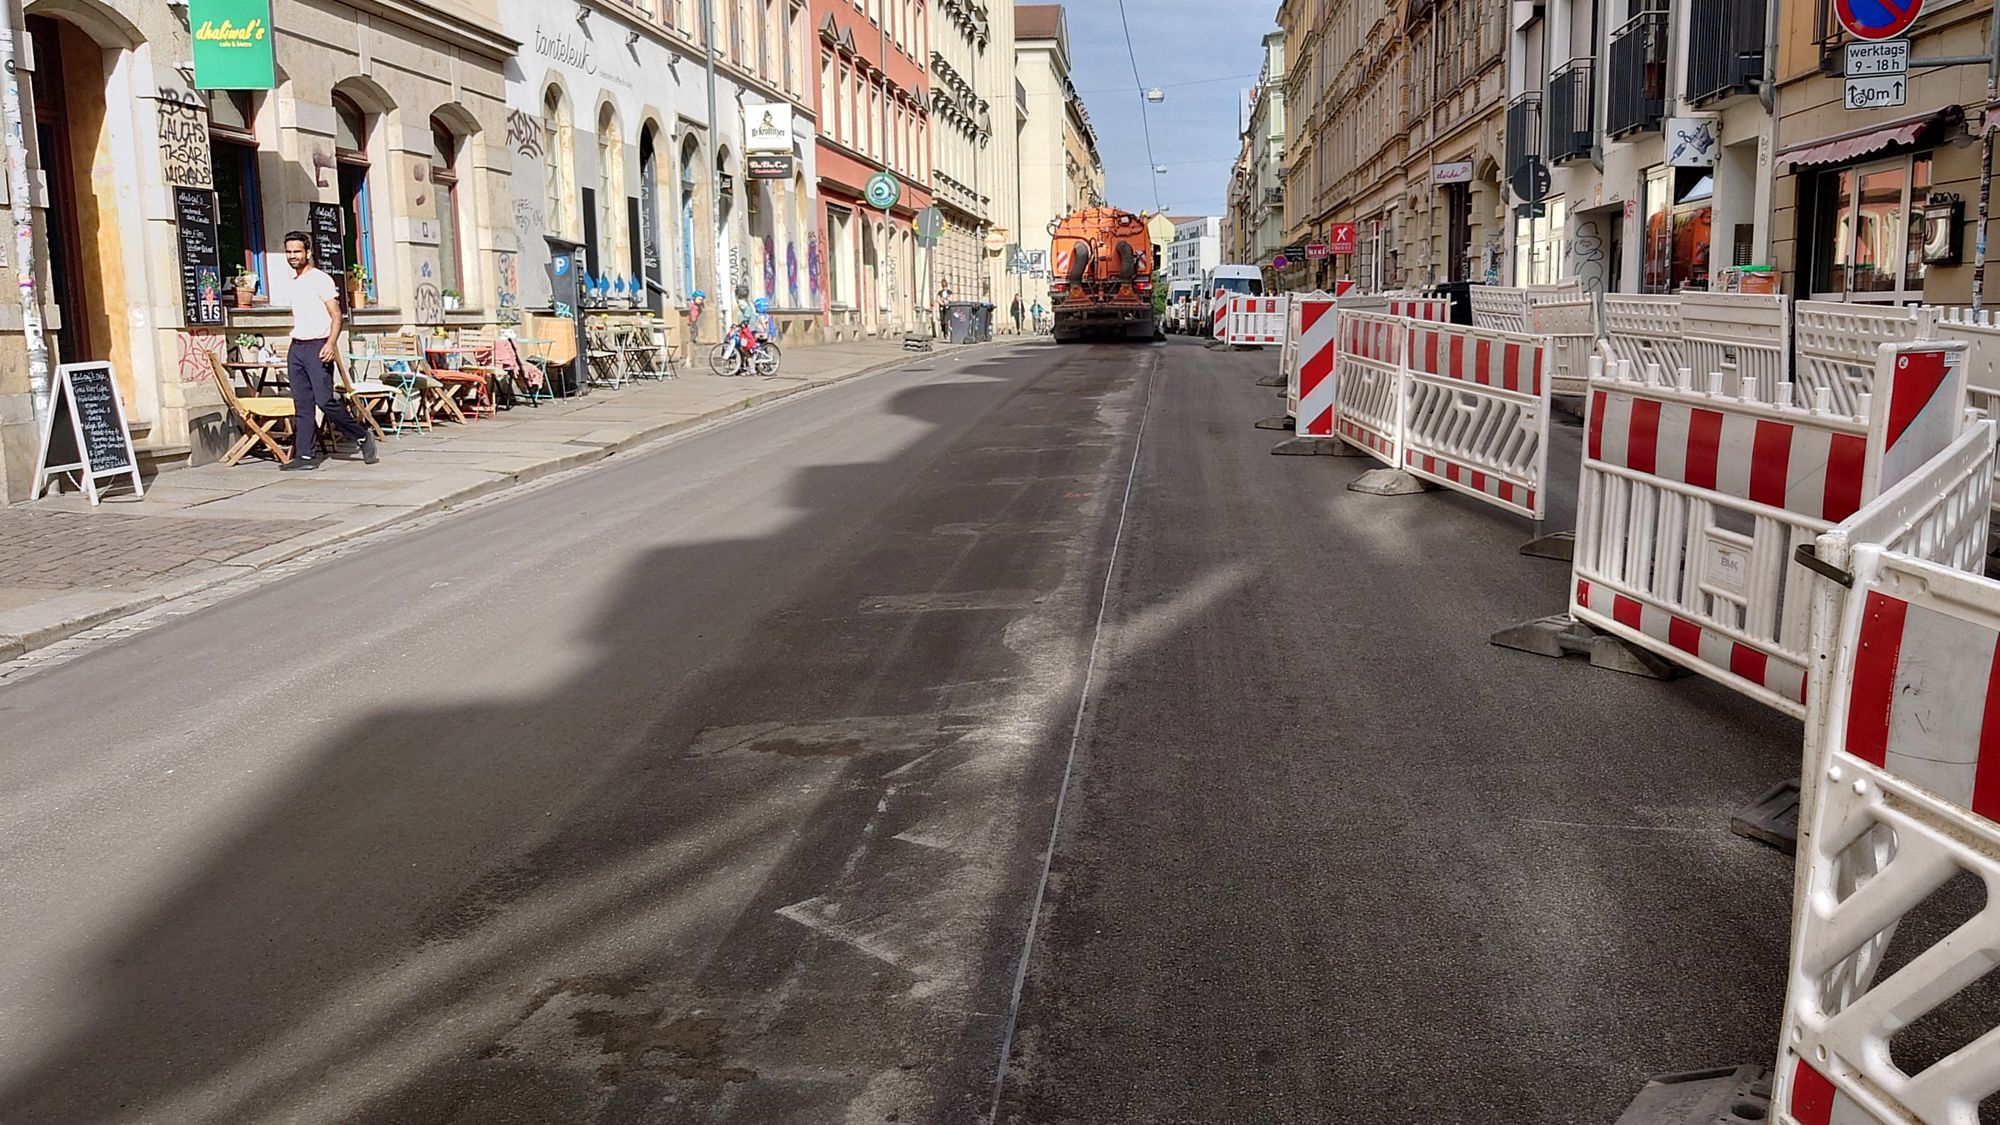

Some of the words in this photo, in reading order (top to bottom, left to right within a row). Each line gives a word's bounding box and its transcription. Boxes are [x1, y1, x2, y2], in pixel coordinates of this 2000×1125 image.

[195, 18, 265, 40] dhaliwal's
[1850, 45, 1905, 57] werktags
[1855, 61, 1862, 72] 9
[1876, 60, 1889, 71] 18
[556, 257, 565, 272] P
[201, 305, 221, 320] EIS
